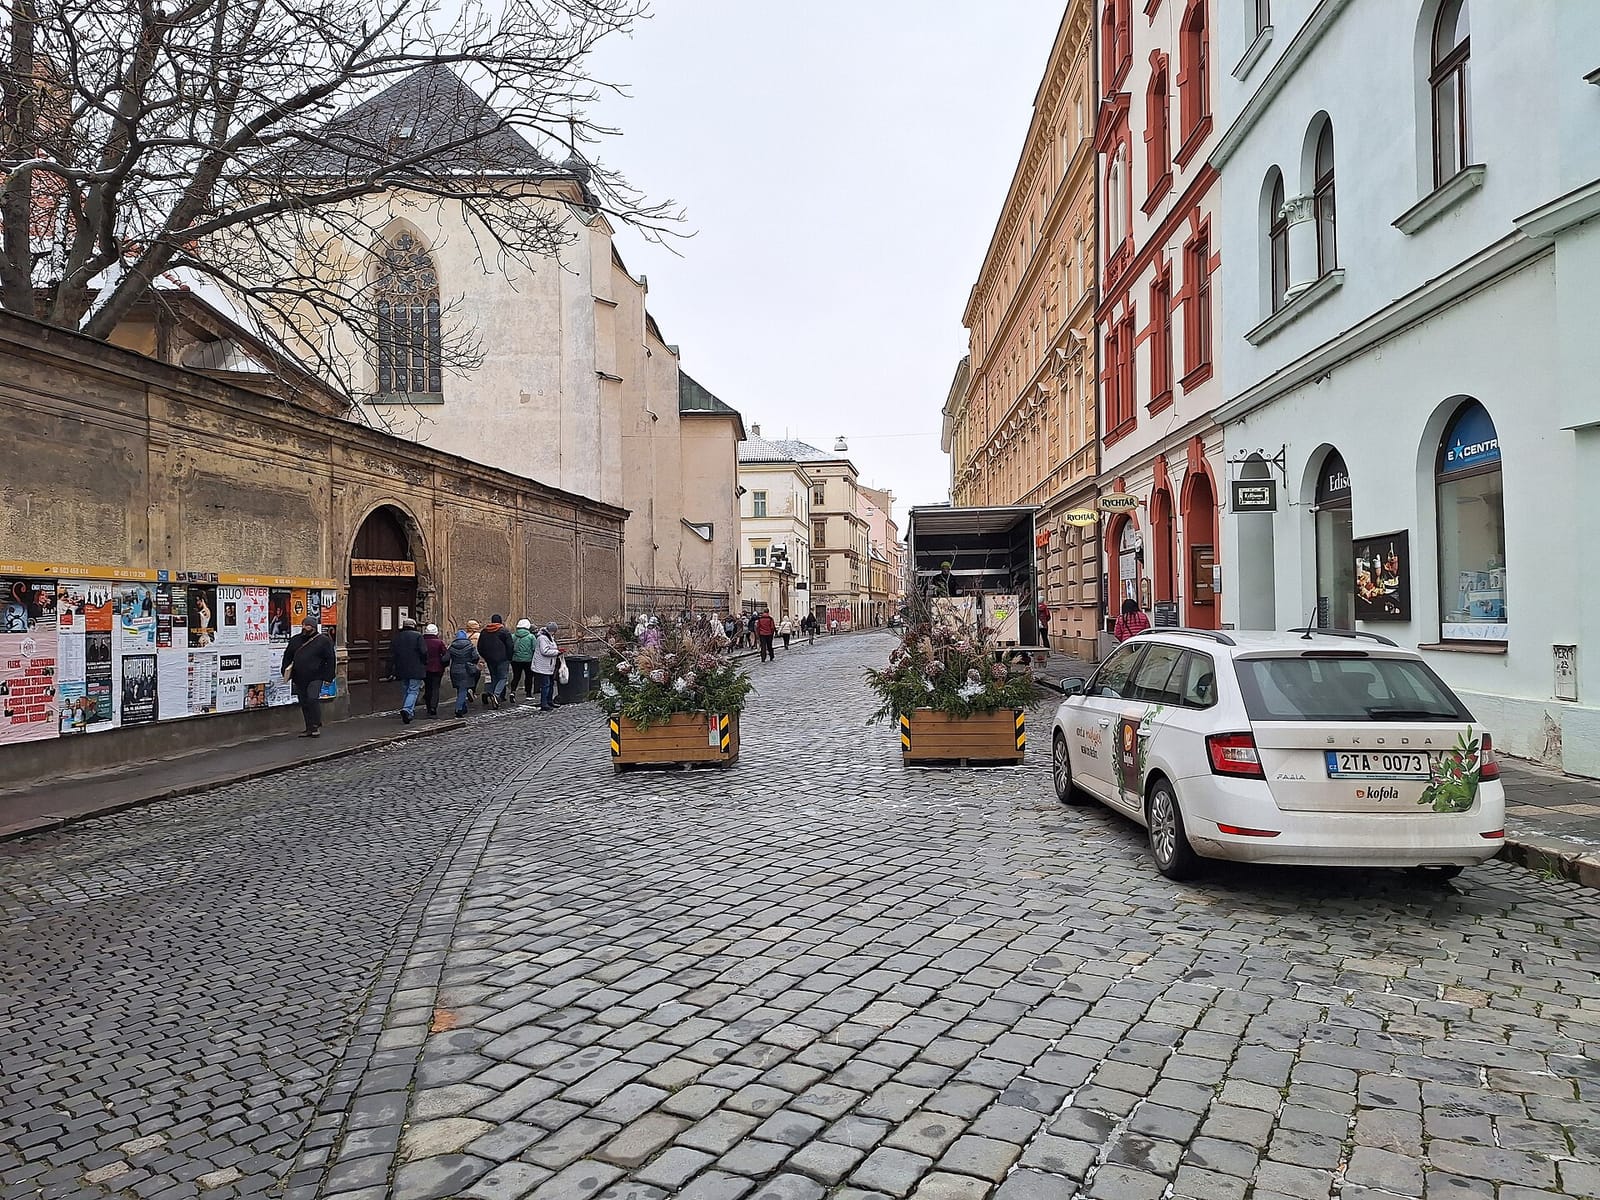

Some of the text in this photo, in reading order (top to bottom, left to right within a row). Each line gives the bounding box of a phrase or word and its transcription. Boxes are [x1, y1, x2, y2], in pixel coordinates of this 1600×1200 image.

[244, 588, 268, 597] NEVER
[221, 658, 240, 668] RENGL
[218, 675, 242, 685] PLAKÁT
[224, 685, 236, 695] 1,49
[1340, 754, 1423, 772] 2TA 0073
[1366, 786, 1399, 803] kofola
